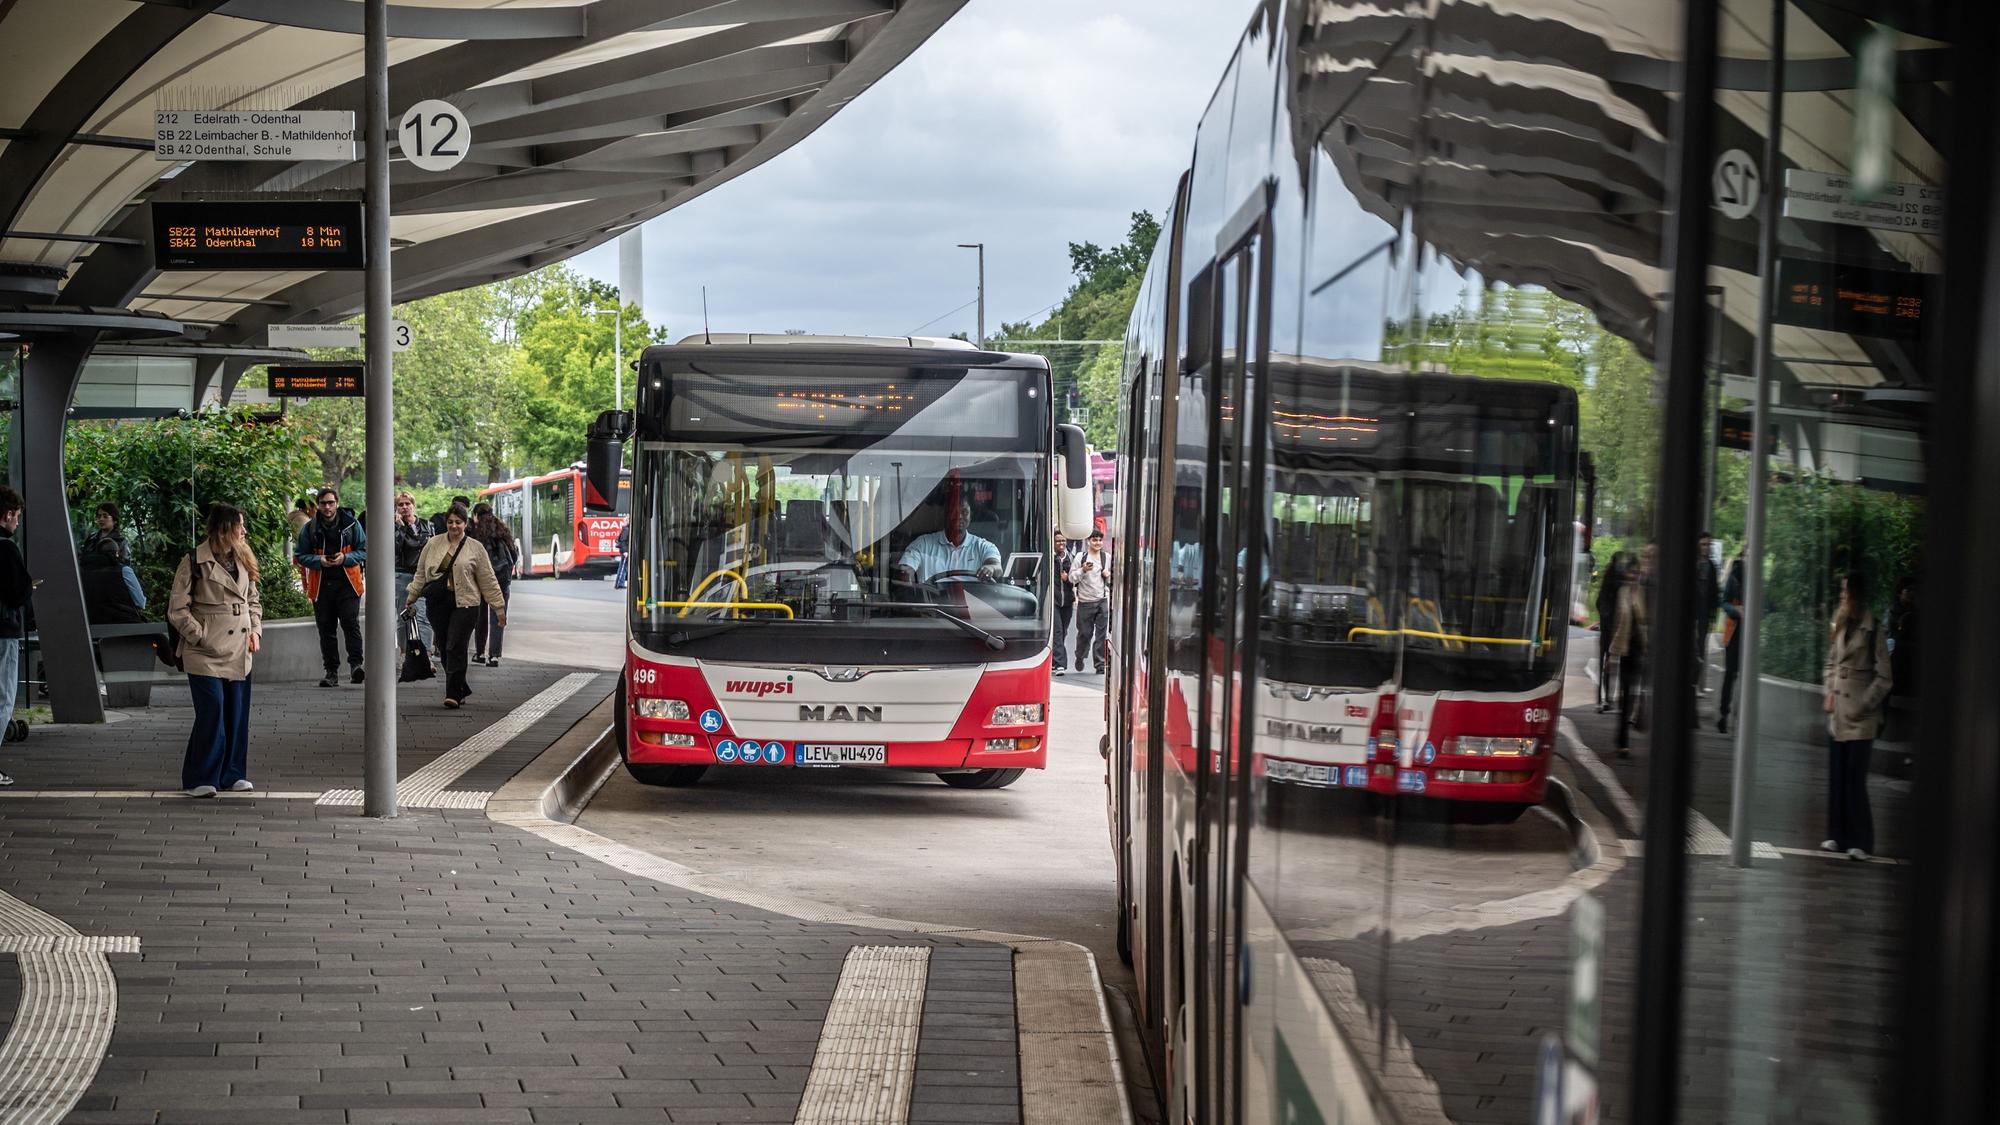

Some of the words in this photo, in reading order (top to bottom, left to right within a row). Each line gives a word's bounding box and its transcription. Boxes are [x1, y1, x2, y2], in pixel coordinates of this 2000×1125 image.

[157, 113, 178, 124] 212
[194, 113, 240, 124] Edelrath
[251, 113, 301, 124] Odenthal
[157, 130, 175, 140] SB
[178, 130, 192, 140] 22
[194, 130, 258, 140] Leimbacher
[261, 130, 273, 140] B.
[282, 130, 352, 140] Mathildenhof
[405, 113, 459, 157] 12
[158, 145, 175, 155] SB
[178, 144, 192, 154] 42
[194, 144, 249, 156] Odenthal,
[253, 144, 292, 155] Schule
[169, 227, 196, 237] SB22
[205, 226, 281, 238] Mathildenhof
[306, 226, 314, 236] 8
[320, 226, 341, 236] Min
[170, 238, 197, 248] SB42
[206, 238, 257, 248] Odenthal
[301, 238, 315, 247] 18
[320, 237, 341, 247] Min
[396, 325, 410, 346] 3
[633, 668, 656, 684] 496
[726, 675, 793, 697] wupsi
[799, 704, 883, 722] MAN
[805, 746, 831, 761] LEV
